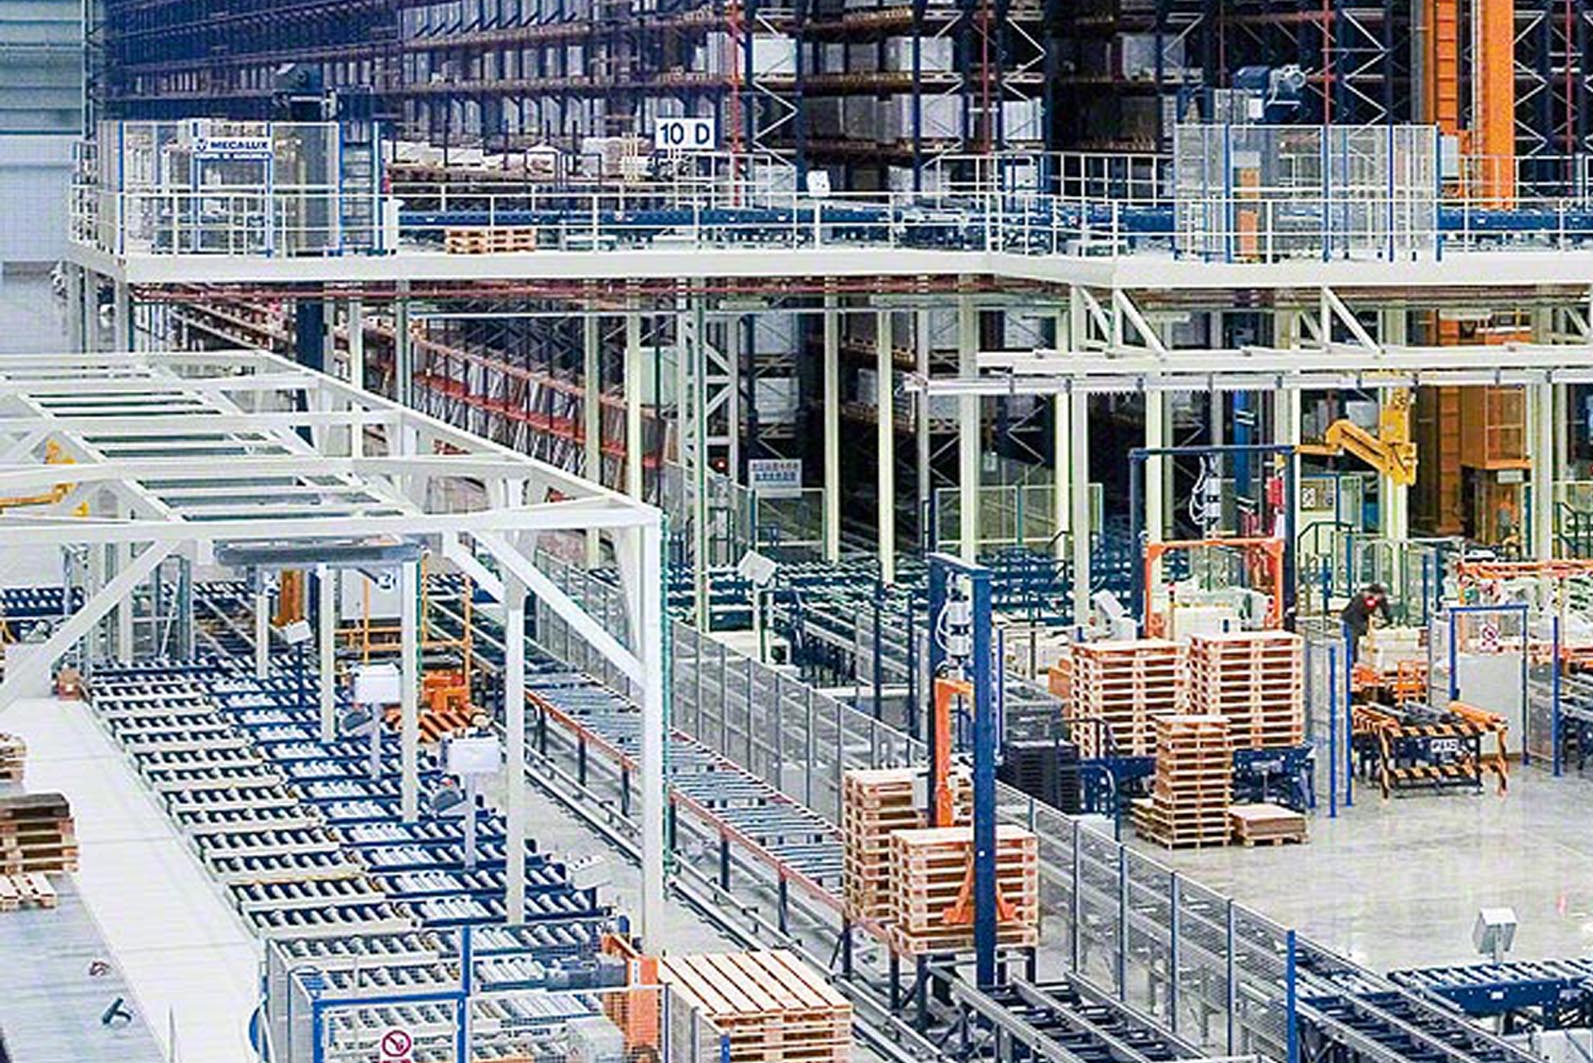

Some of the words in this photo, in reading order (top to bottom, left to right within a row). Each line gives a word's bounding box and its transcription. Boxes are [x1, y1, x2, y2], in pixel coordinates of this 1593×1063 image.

[660, 122, 684, 145] 10
[695, 122, 710, 145] D
[210, 141, 268, 150] MECALUX
